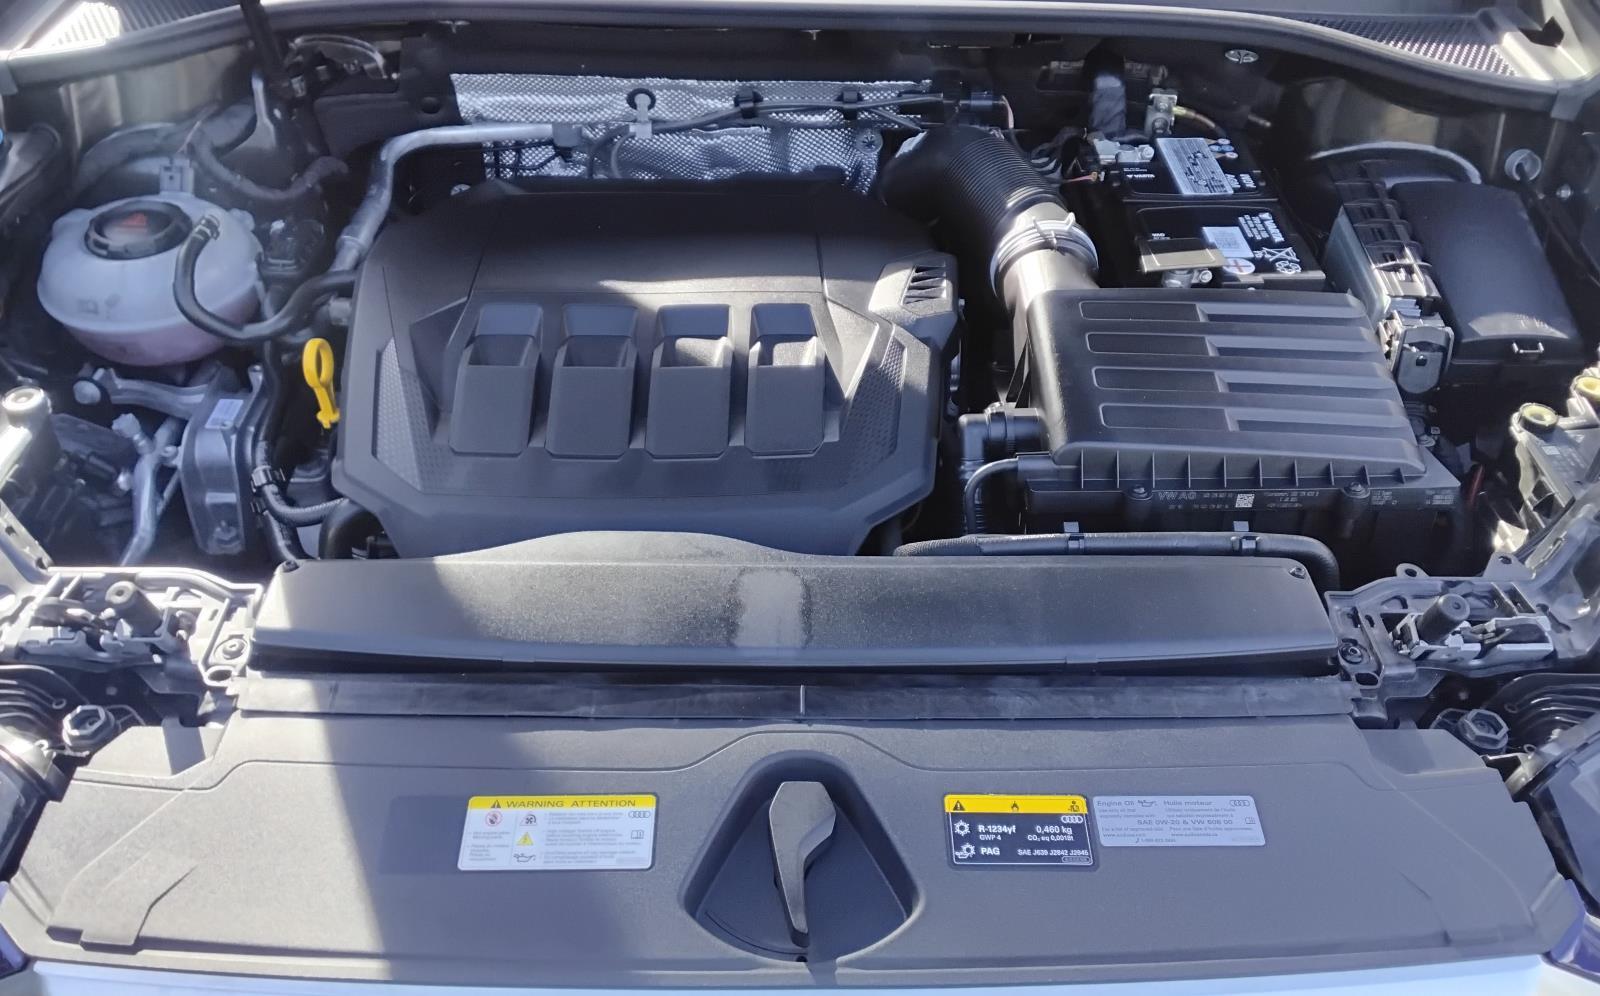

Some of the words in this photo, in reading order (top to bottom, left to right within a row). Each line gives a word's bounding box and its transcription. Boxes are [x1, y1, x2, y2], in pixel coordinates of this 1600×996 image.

[507, 800, 564, 808] WARNING
[571, 800, 636, 808] ATTENTION
[978, 825, 1016, 834] R-1234yf
[1036, 825, 1060, 834] 0,460
[1062, 825, 1073, 834] kg
[981, 847, 1001, 855] PAG
